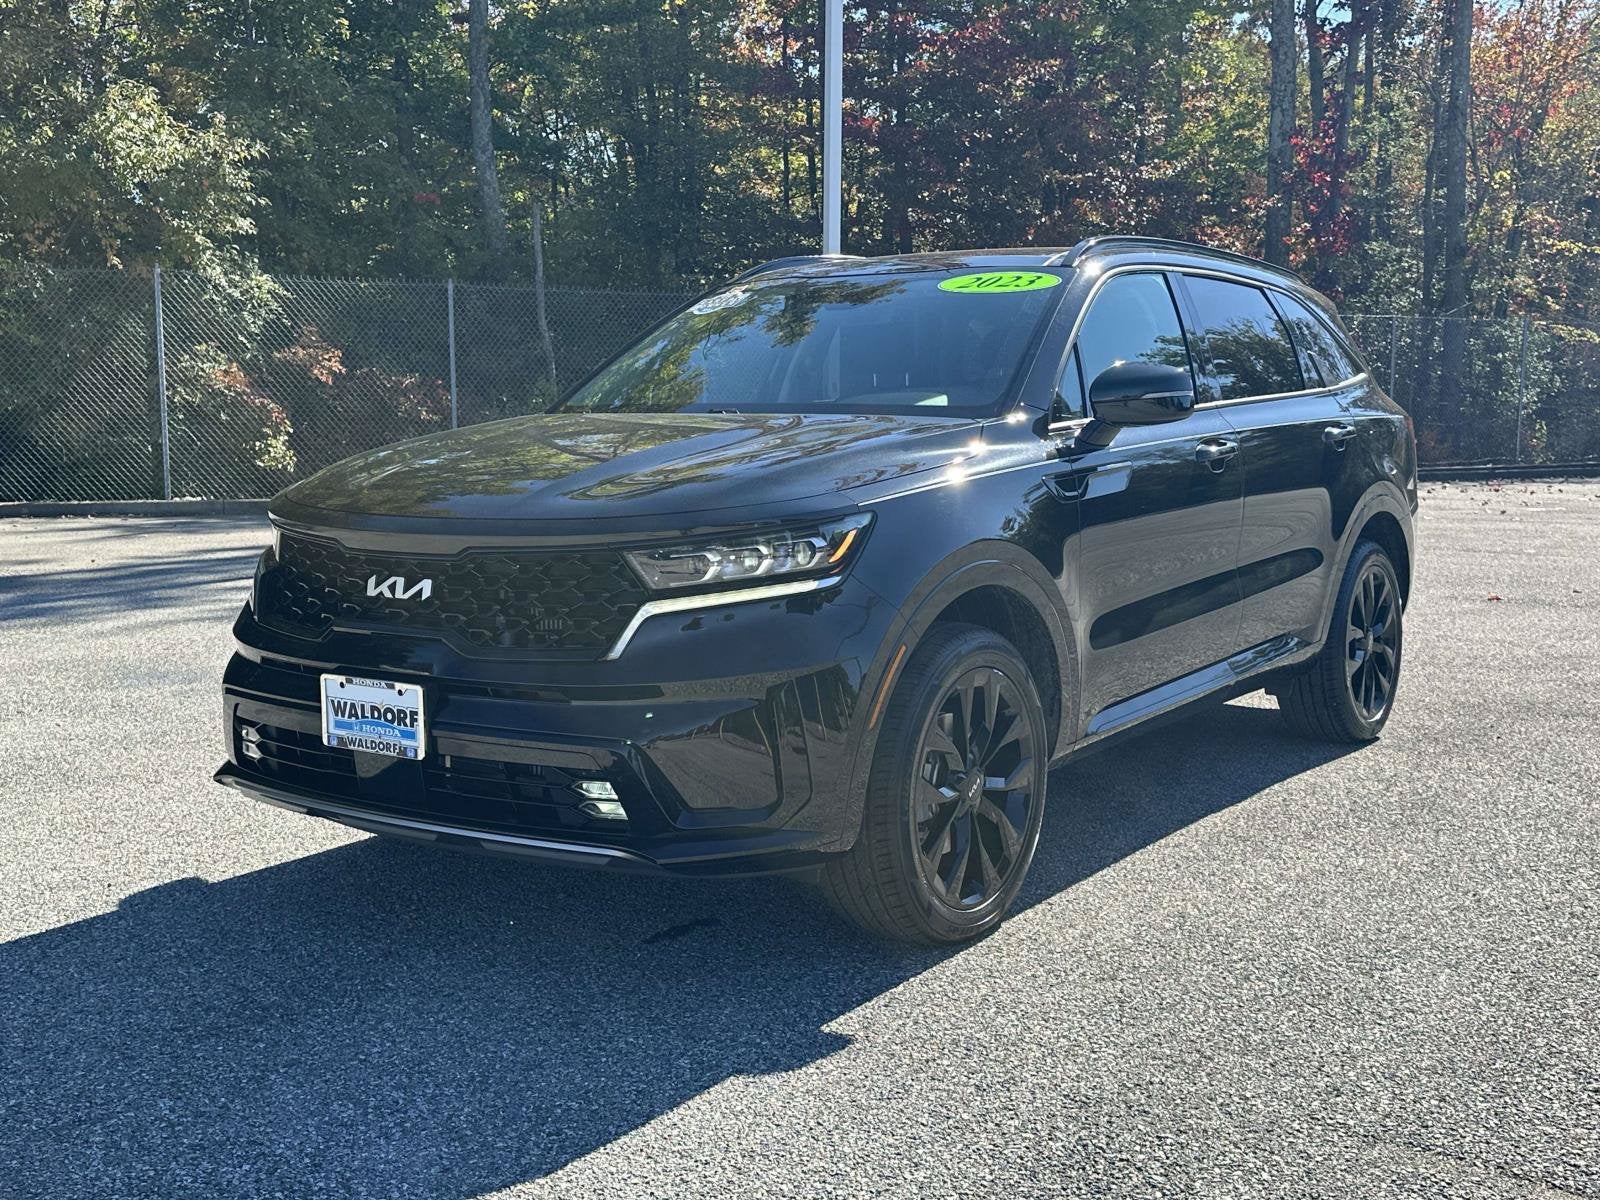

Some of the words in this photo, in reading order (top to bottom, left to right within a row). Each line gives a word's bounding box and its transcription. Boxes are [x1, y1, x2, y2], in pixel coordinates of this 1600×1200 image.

[956, 276, 1043, 289] 2023
[366, 574, 433, 601] KIA
[352, 677, 388, 689] HONDA
[329, 698, 419, 729] WALDORF
[361, 724, 402, 737] HONDA
[346, 735, 400, 754] WALDORF
